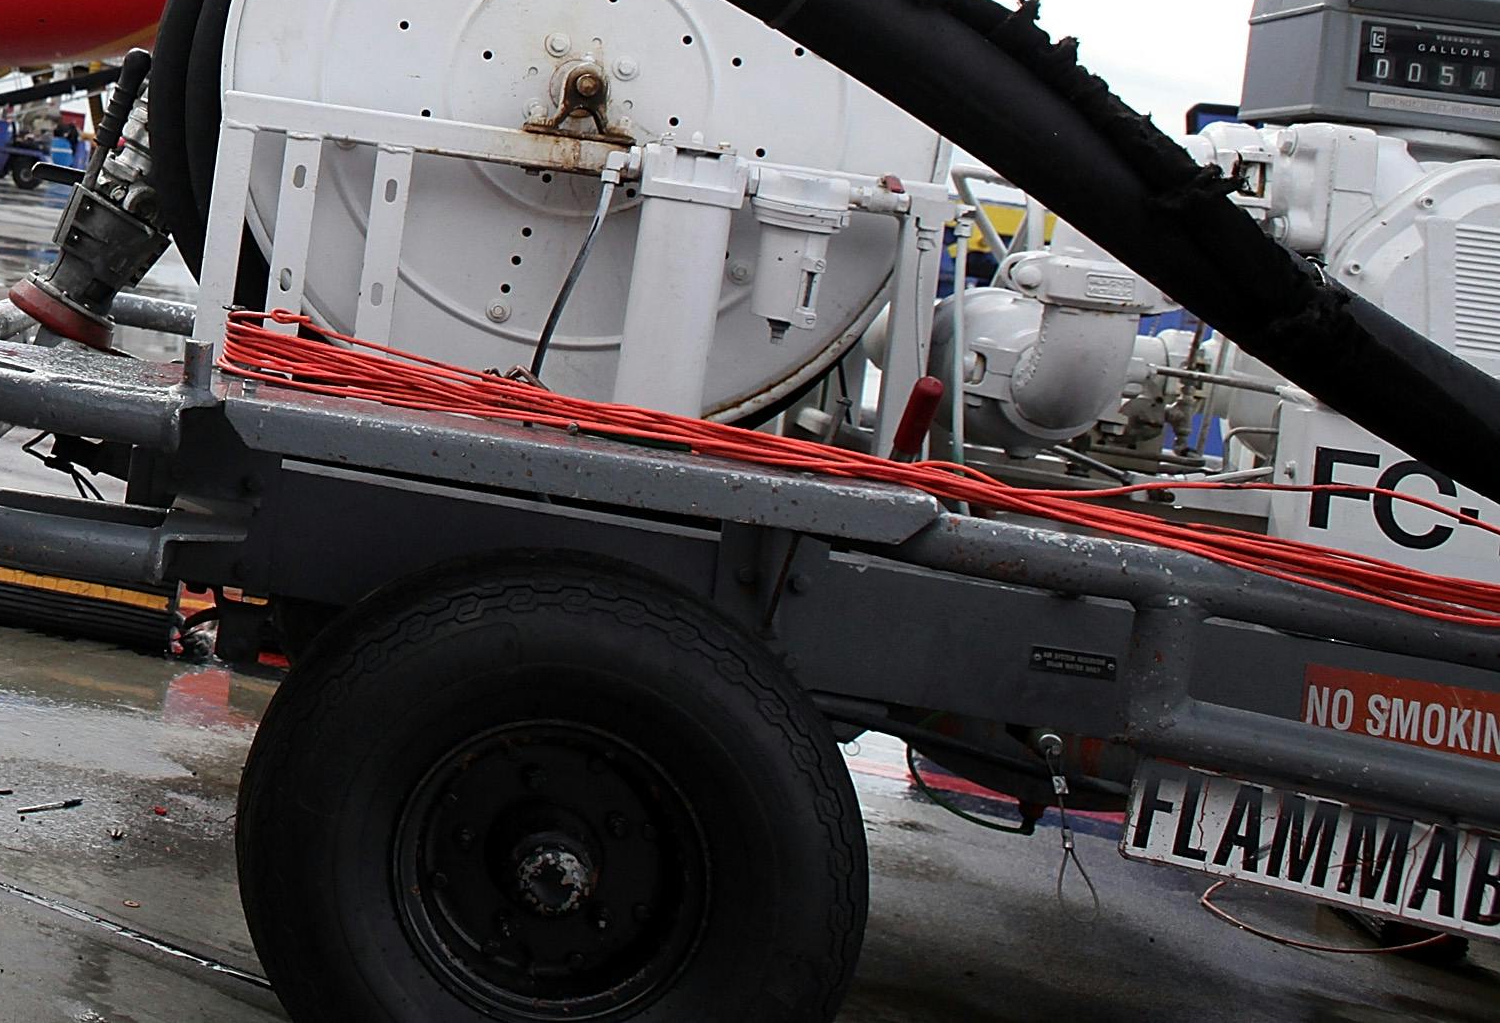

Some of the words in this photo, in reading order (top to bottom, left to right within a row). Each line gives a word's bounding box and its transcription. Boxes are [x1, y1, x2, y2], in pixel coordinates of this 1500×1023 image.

[1418, 43, 1490, 58] GALLONS
[1308, 446, 1500, 556] FC-
[1305, 685, 1354, 731] NO
